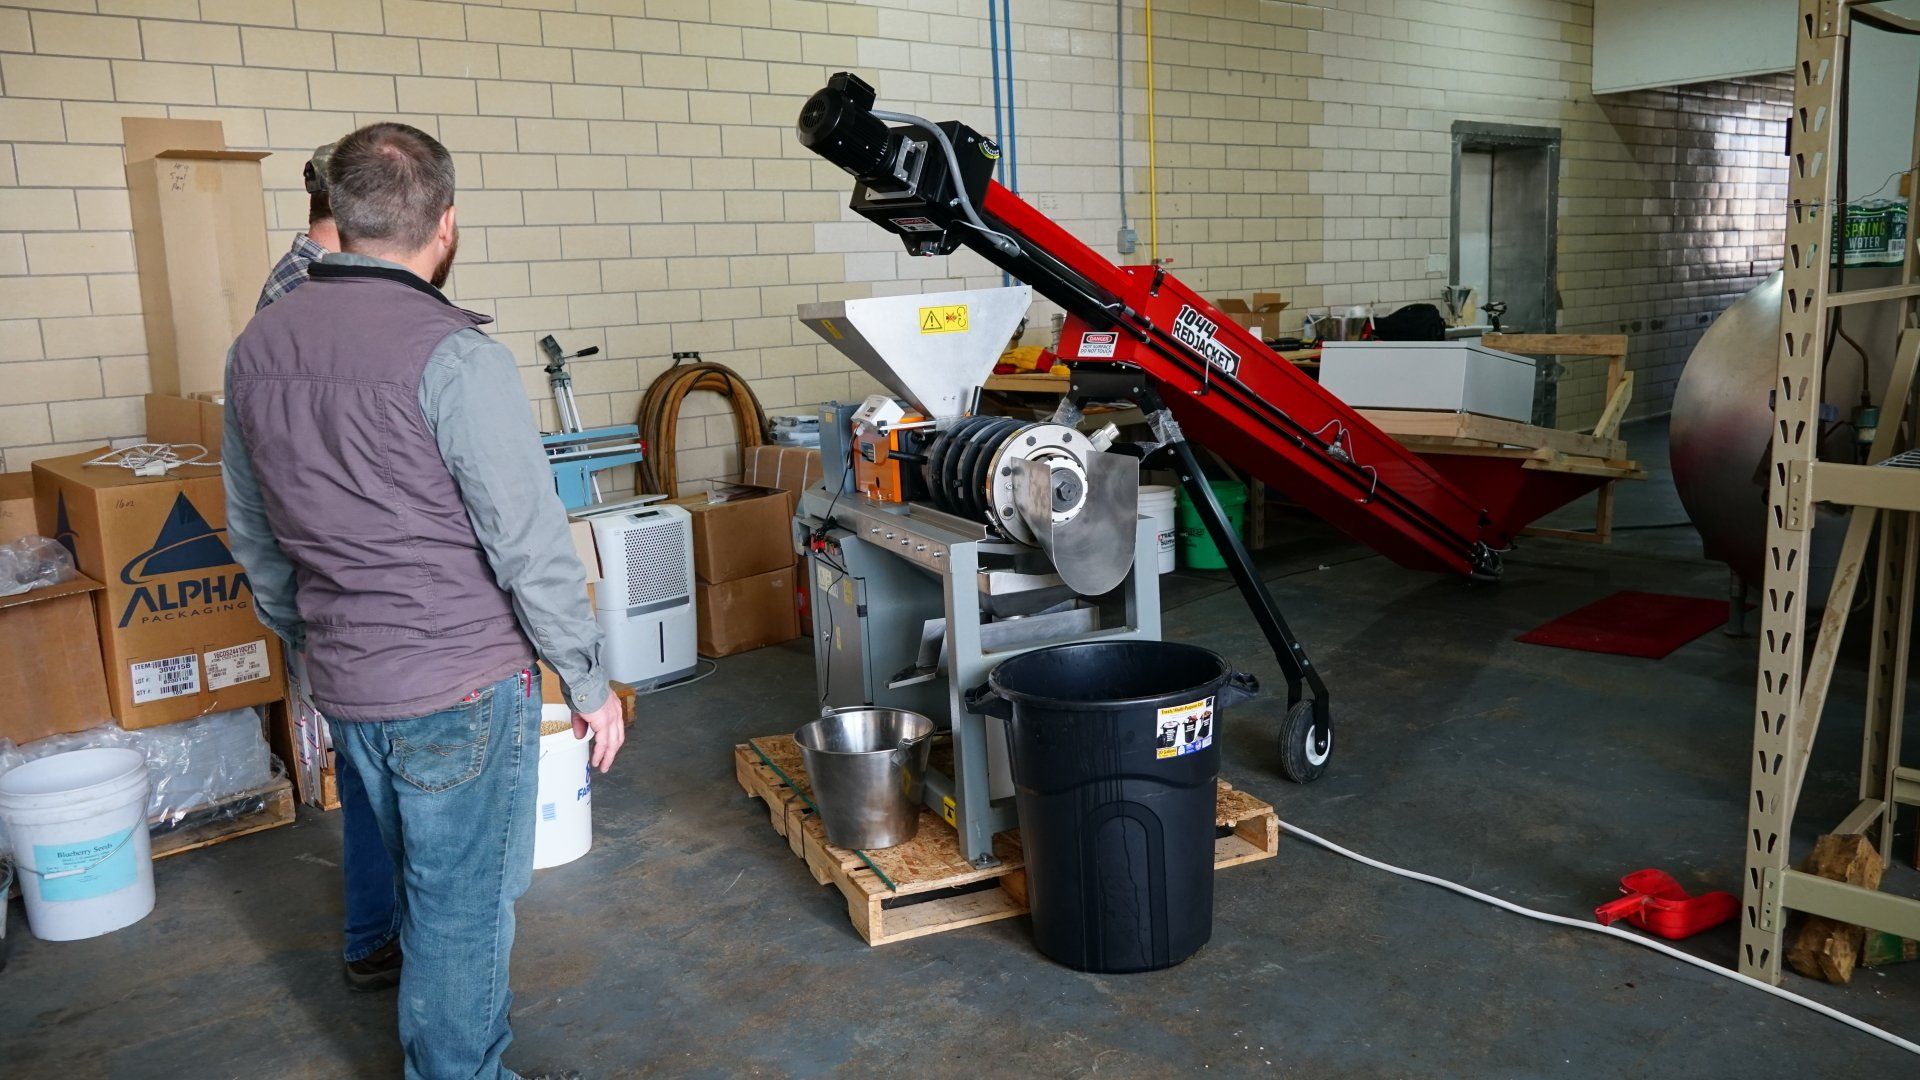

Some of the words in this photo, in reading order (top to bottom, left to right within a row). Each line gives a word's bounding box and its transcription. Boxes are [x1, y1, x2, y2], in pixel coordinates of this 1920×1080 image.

[1845, 222, 1886, 238] SPRING
[1848, 236, 1881, 249] WATER
[1178, 305, 1217, 340] 1044
[1173, 320, 1232, 371] REDJACKET
[118, 572, 255, 628] ALPHA
[141, 601, 247, 624] PACKAGING
[57, 848, 91, 858] Blueberry
[93, 843, 113, 852] Seeds
